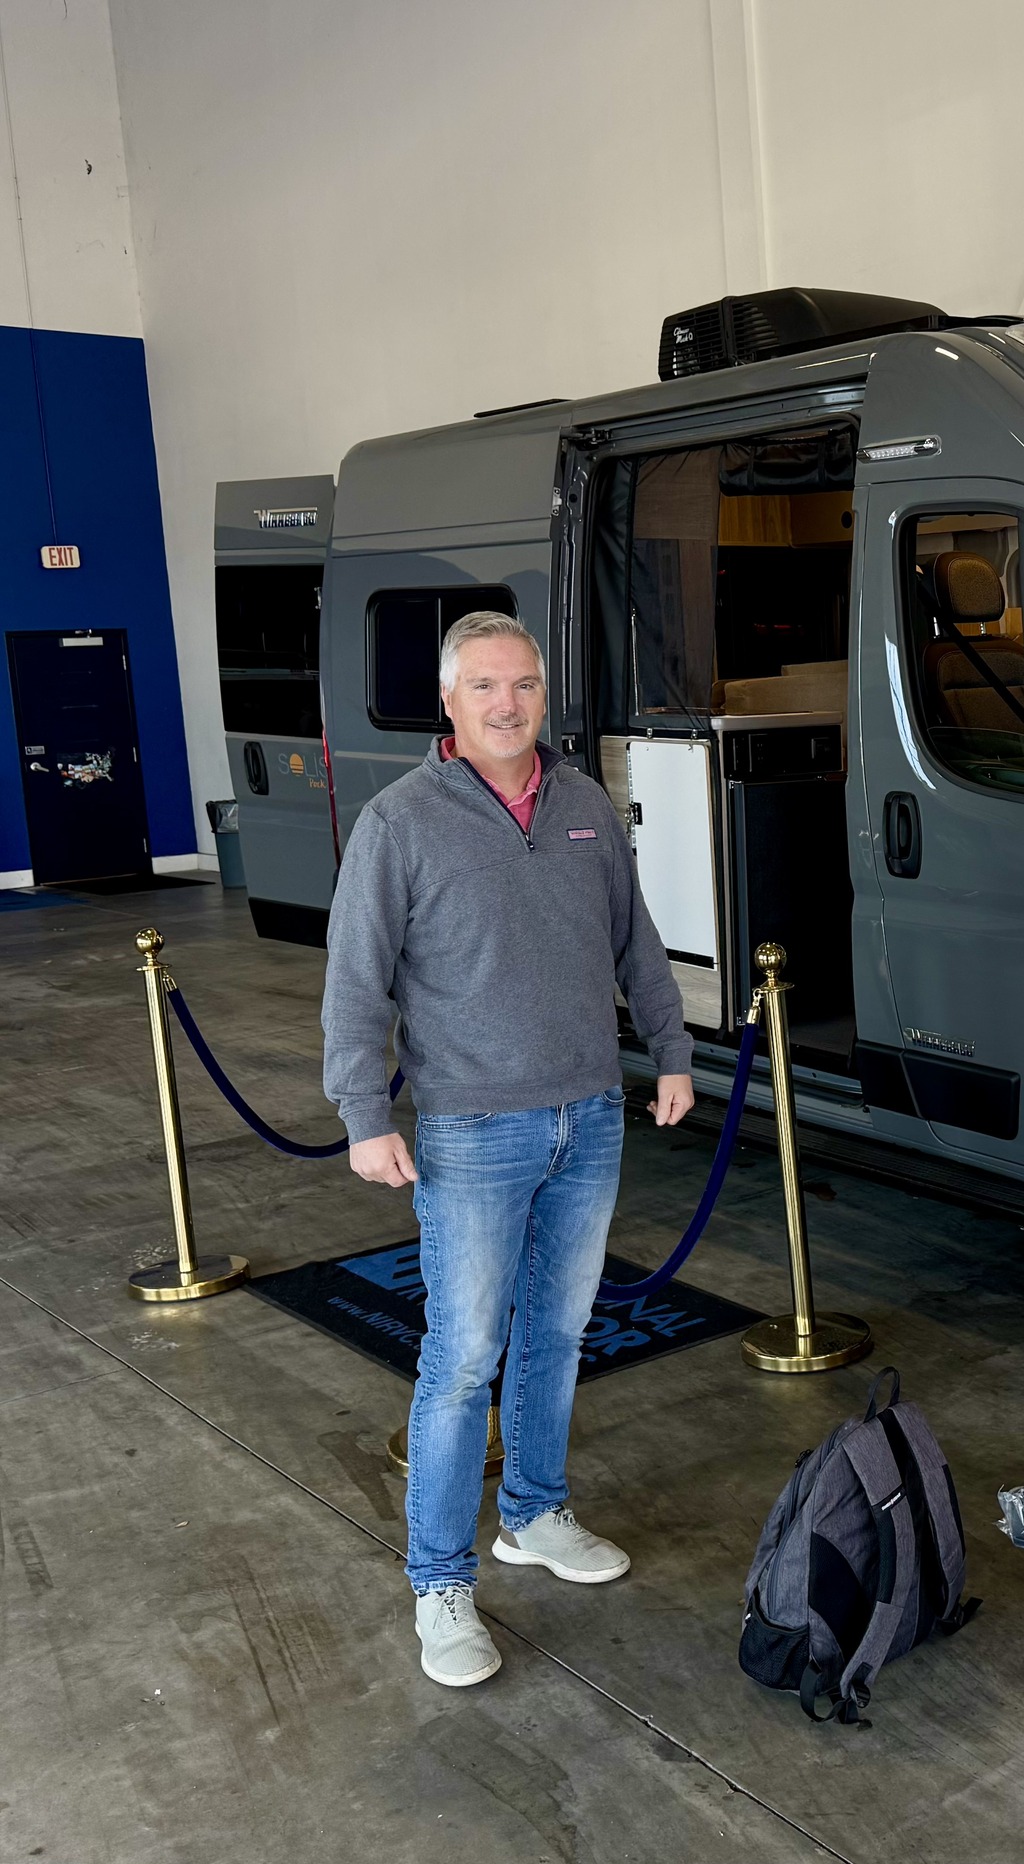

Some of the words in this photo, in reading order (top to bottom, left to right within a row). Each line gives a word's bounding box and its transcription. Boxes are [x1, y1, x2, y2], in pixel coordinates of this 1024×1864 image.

[48, 547, 74, 567] EXIT
[309, 778, 328, 789] Pock
[326, 1295, 424, 1351] www.NIRVC.c
